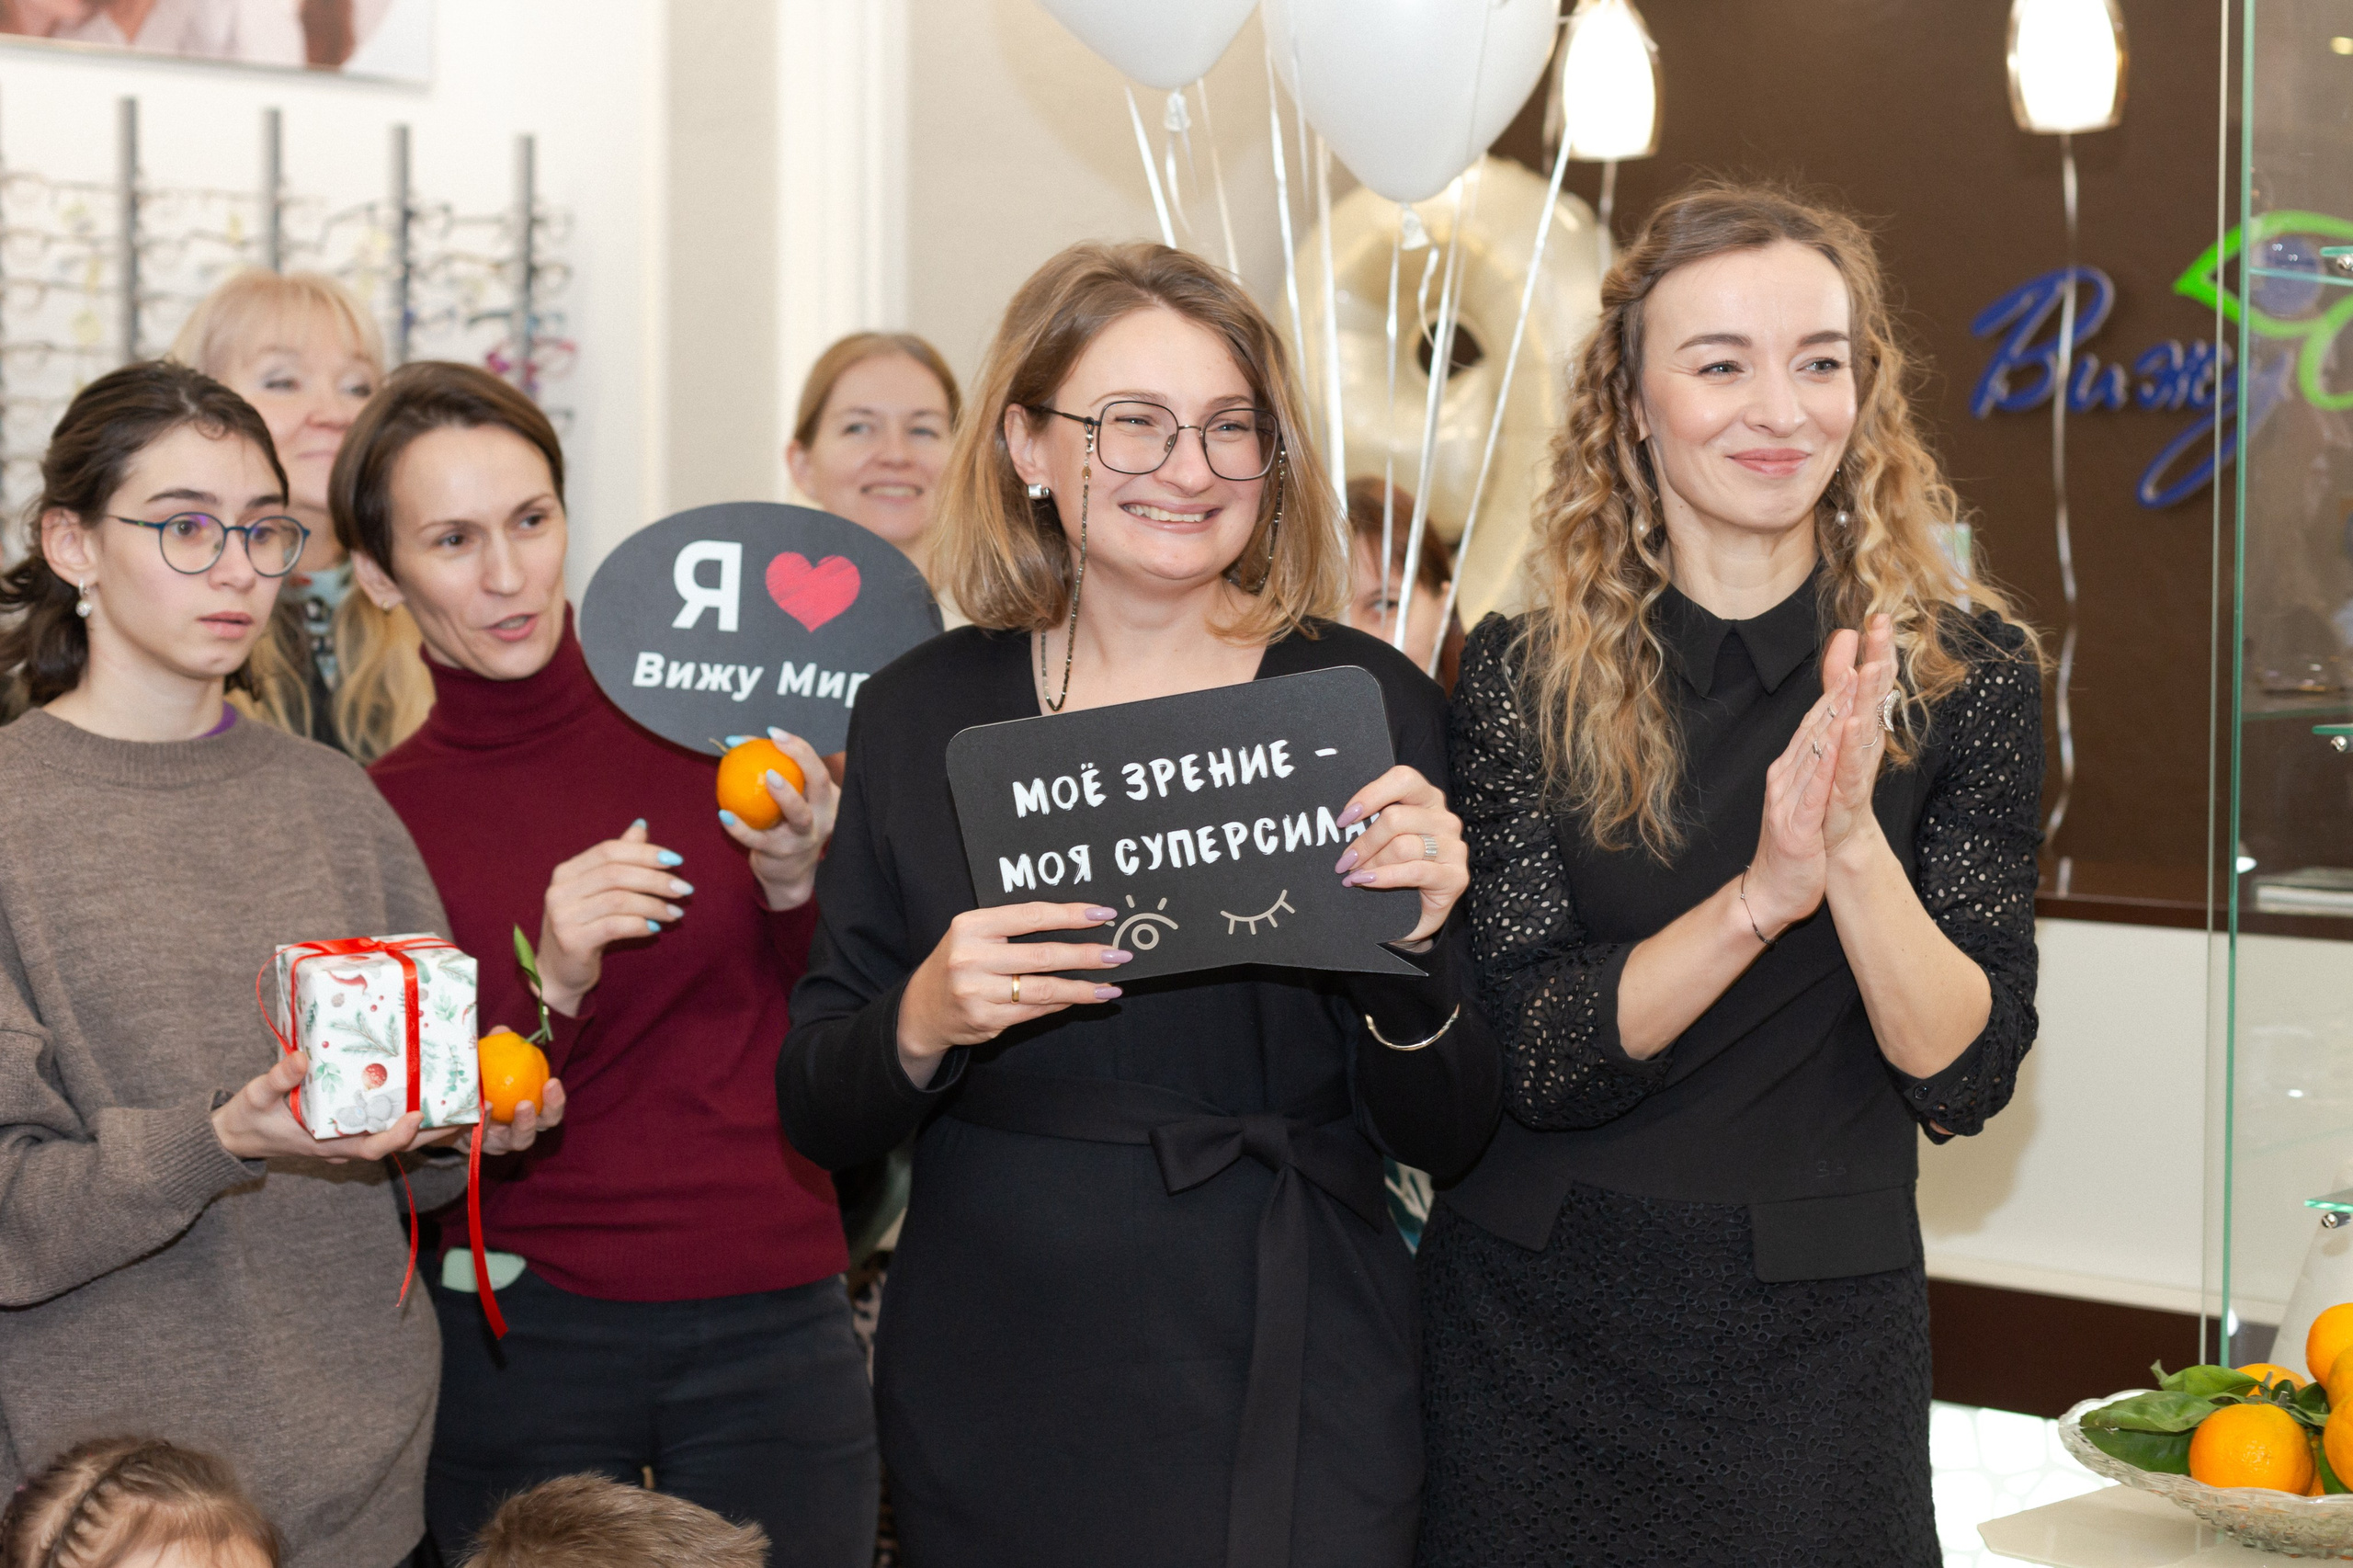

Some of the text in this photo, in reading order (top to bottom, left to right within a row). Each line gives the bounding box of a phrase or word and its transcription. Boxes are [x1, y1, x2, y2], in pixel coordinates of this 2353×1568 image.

[1970, 266, 2294, 508] Вижу
[672, 540, 743, 632] Я
[632, 652, 764, 702] Вижу
[1012, 763, 1107, 818] МОЁ
[1120, 739, 1295, 801] ЗРЕНИЕ
[998, 844, 1092, 893] МОЯ
